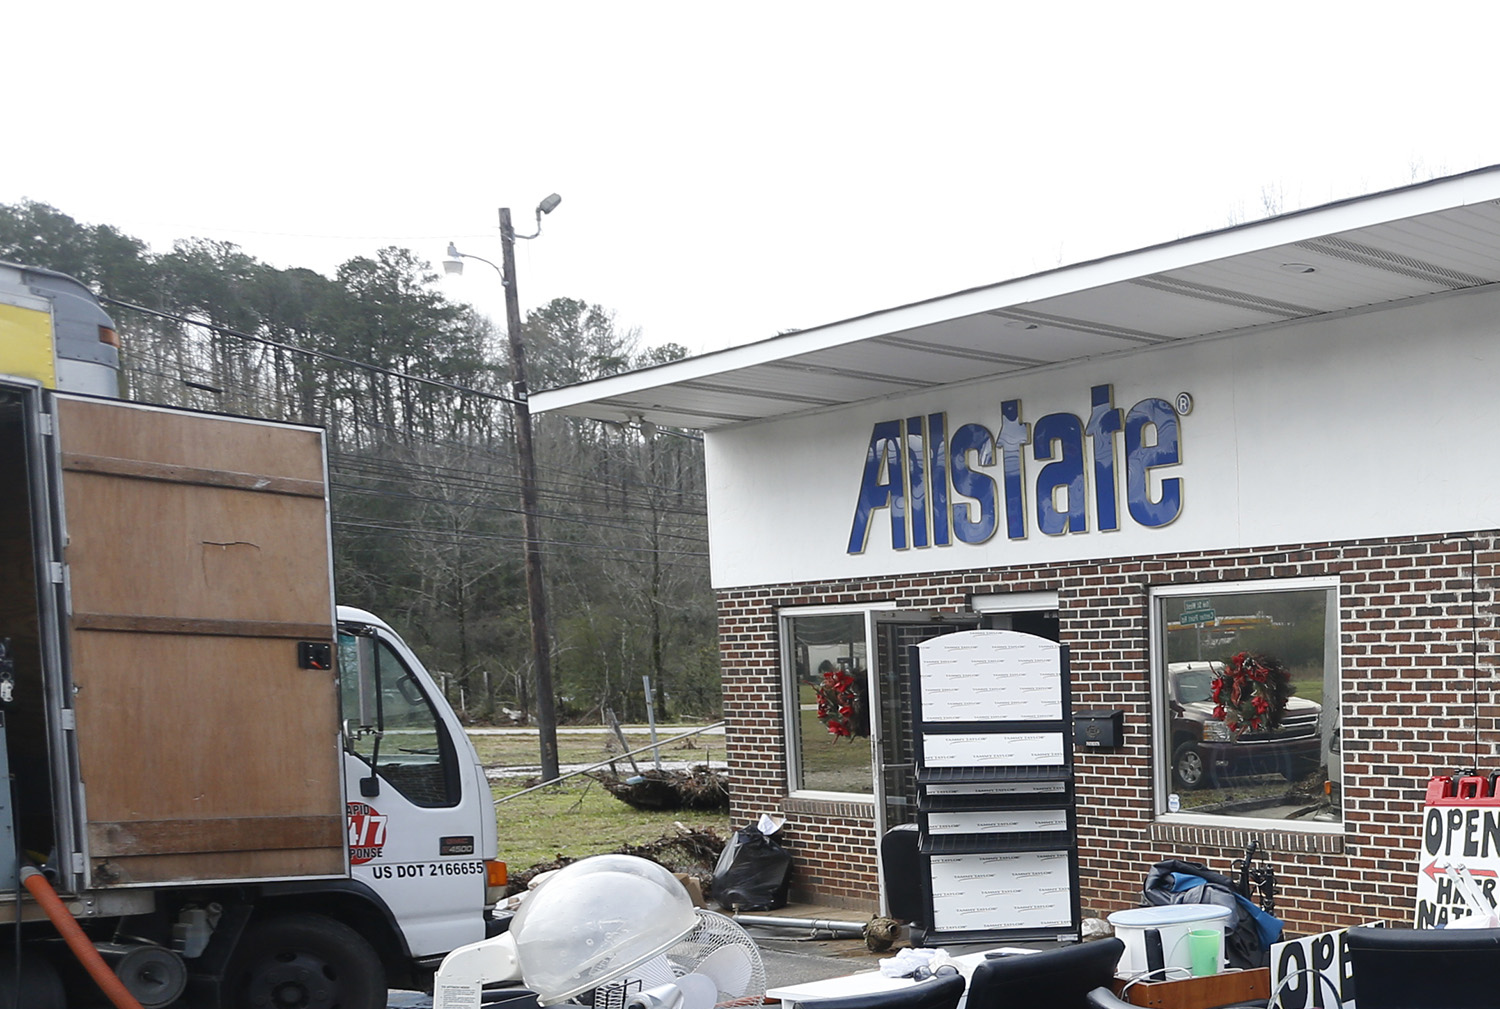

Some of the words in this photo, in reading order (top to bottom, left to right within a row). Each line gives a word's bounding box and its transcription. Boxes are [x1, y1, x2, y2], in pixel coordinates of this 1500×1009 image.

[347, 805, 370, 815] APID
[348, 815, 388, 846] 4/7
[350, 847, 383, 859] PONSE
[373, 866, 393, 879] US
[397, 864, 425, 878] DOT
[429, 862, 484, 876] 2166655
[1436, 877, 1498, 910] HAR
